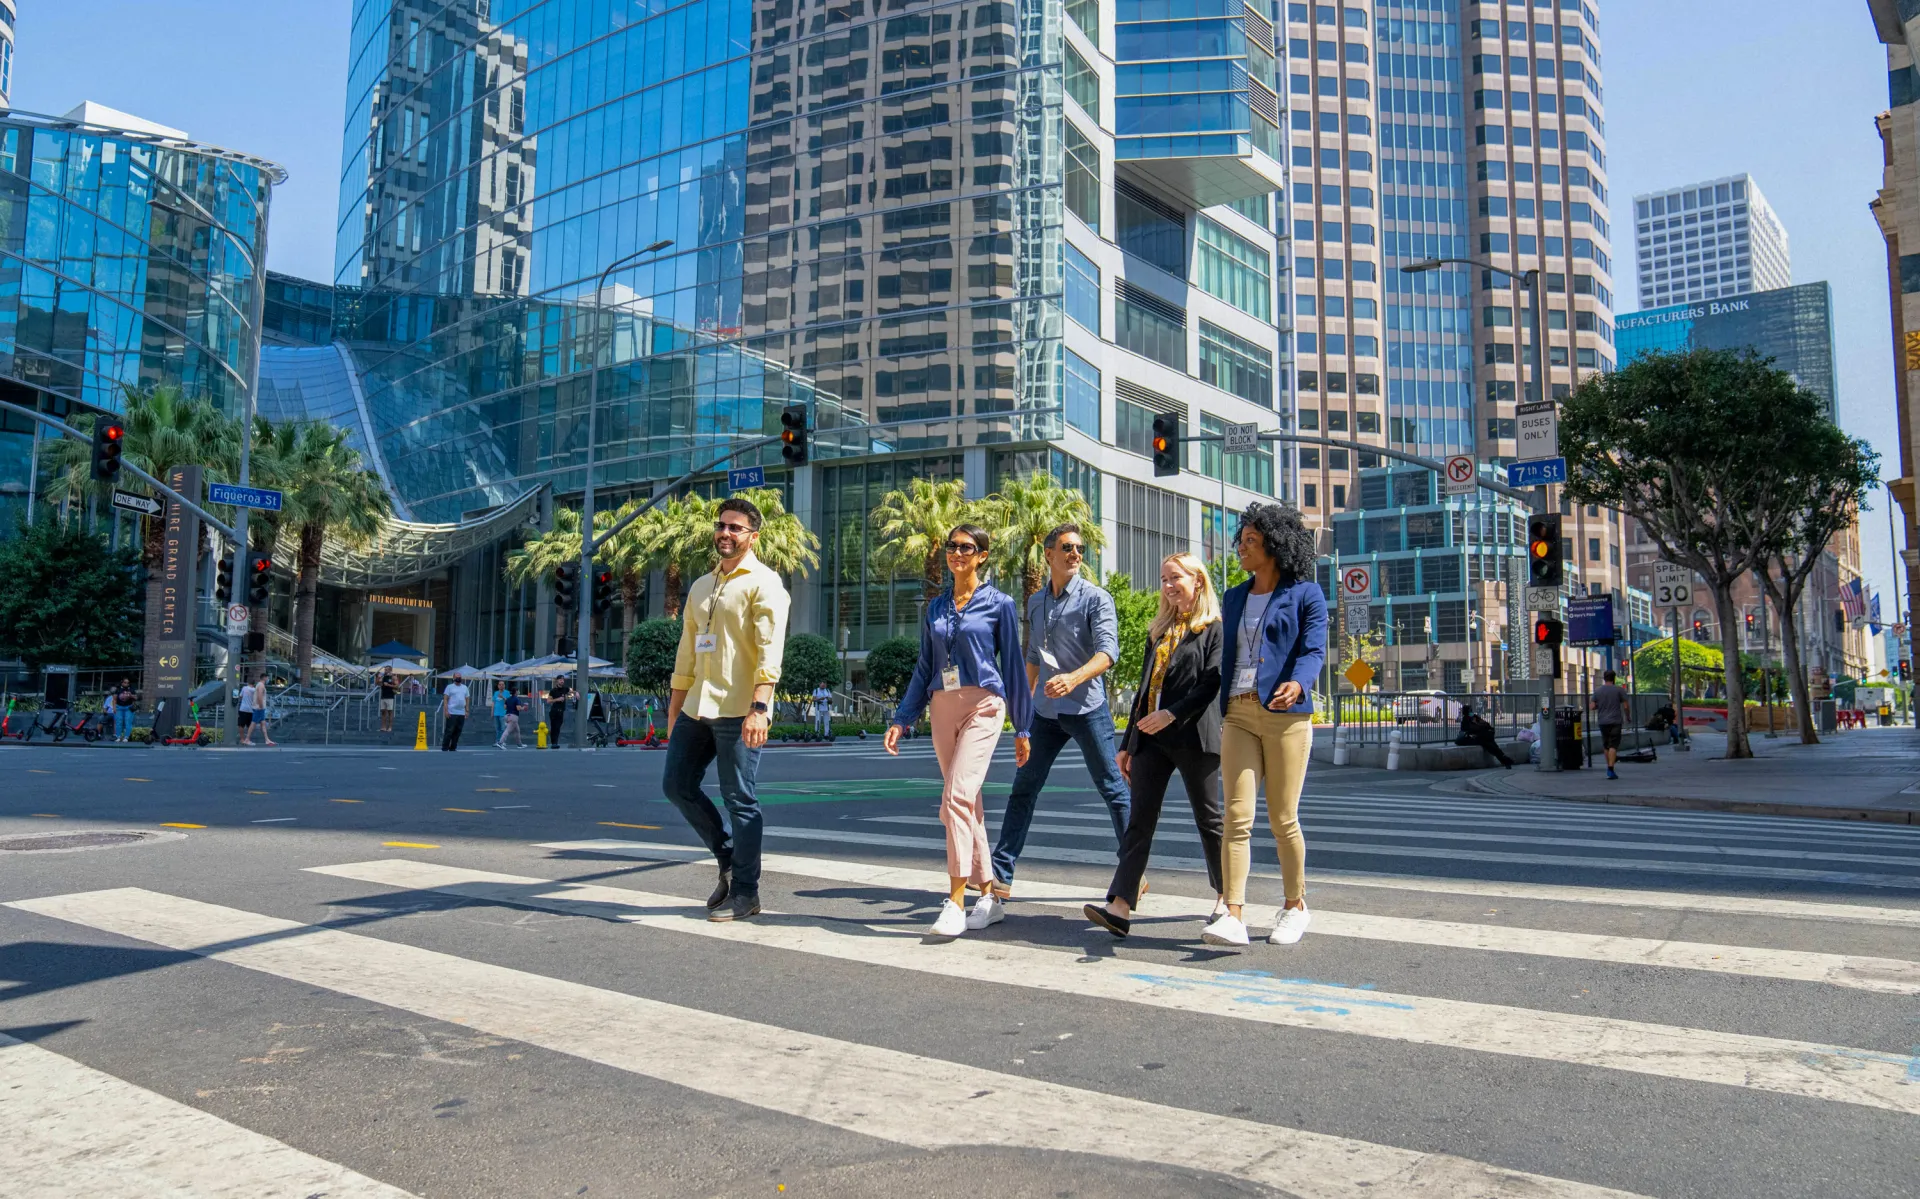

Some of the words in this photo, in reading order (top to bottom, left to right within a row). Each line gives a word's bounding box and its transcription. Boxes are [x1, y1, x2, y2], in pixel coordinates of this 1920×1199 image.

[1710, 300, 1749, 315] BANK
[1229, 426, 1237, 435] DO
[1240, 425, 1253, 434] NOT
[1521, 417, 1550, 428] BUSES
[1230, 435, 1251, 445] BLOCK
[1524, 430, 1548, 440] ONLY
[733, 472, 746, 486] 7th
[749, 471, 759, 482] St
[1515, 466, 1537, 482] 7th
[1543, 465, 1558, 478] St
[116, 494, 131, 504] ONE
[135, 498, 150, 508] WAY
[169, 472, 183, 532] WILHIRE
[214, 488, 261, 503] Figueroa
[265, 495, 277, 506] St
[166, 539, 178, 580] GRAND
[1659, 574, 1685, 583] LIMIT
[1659, 585, 1688, 603] 30
[164, 587, 175, 634] CENTER
